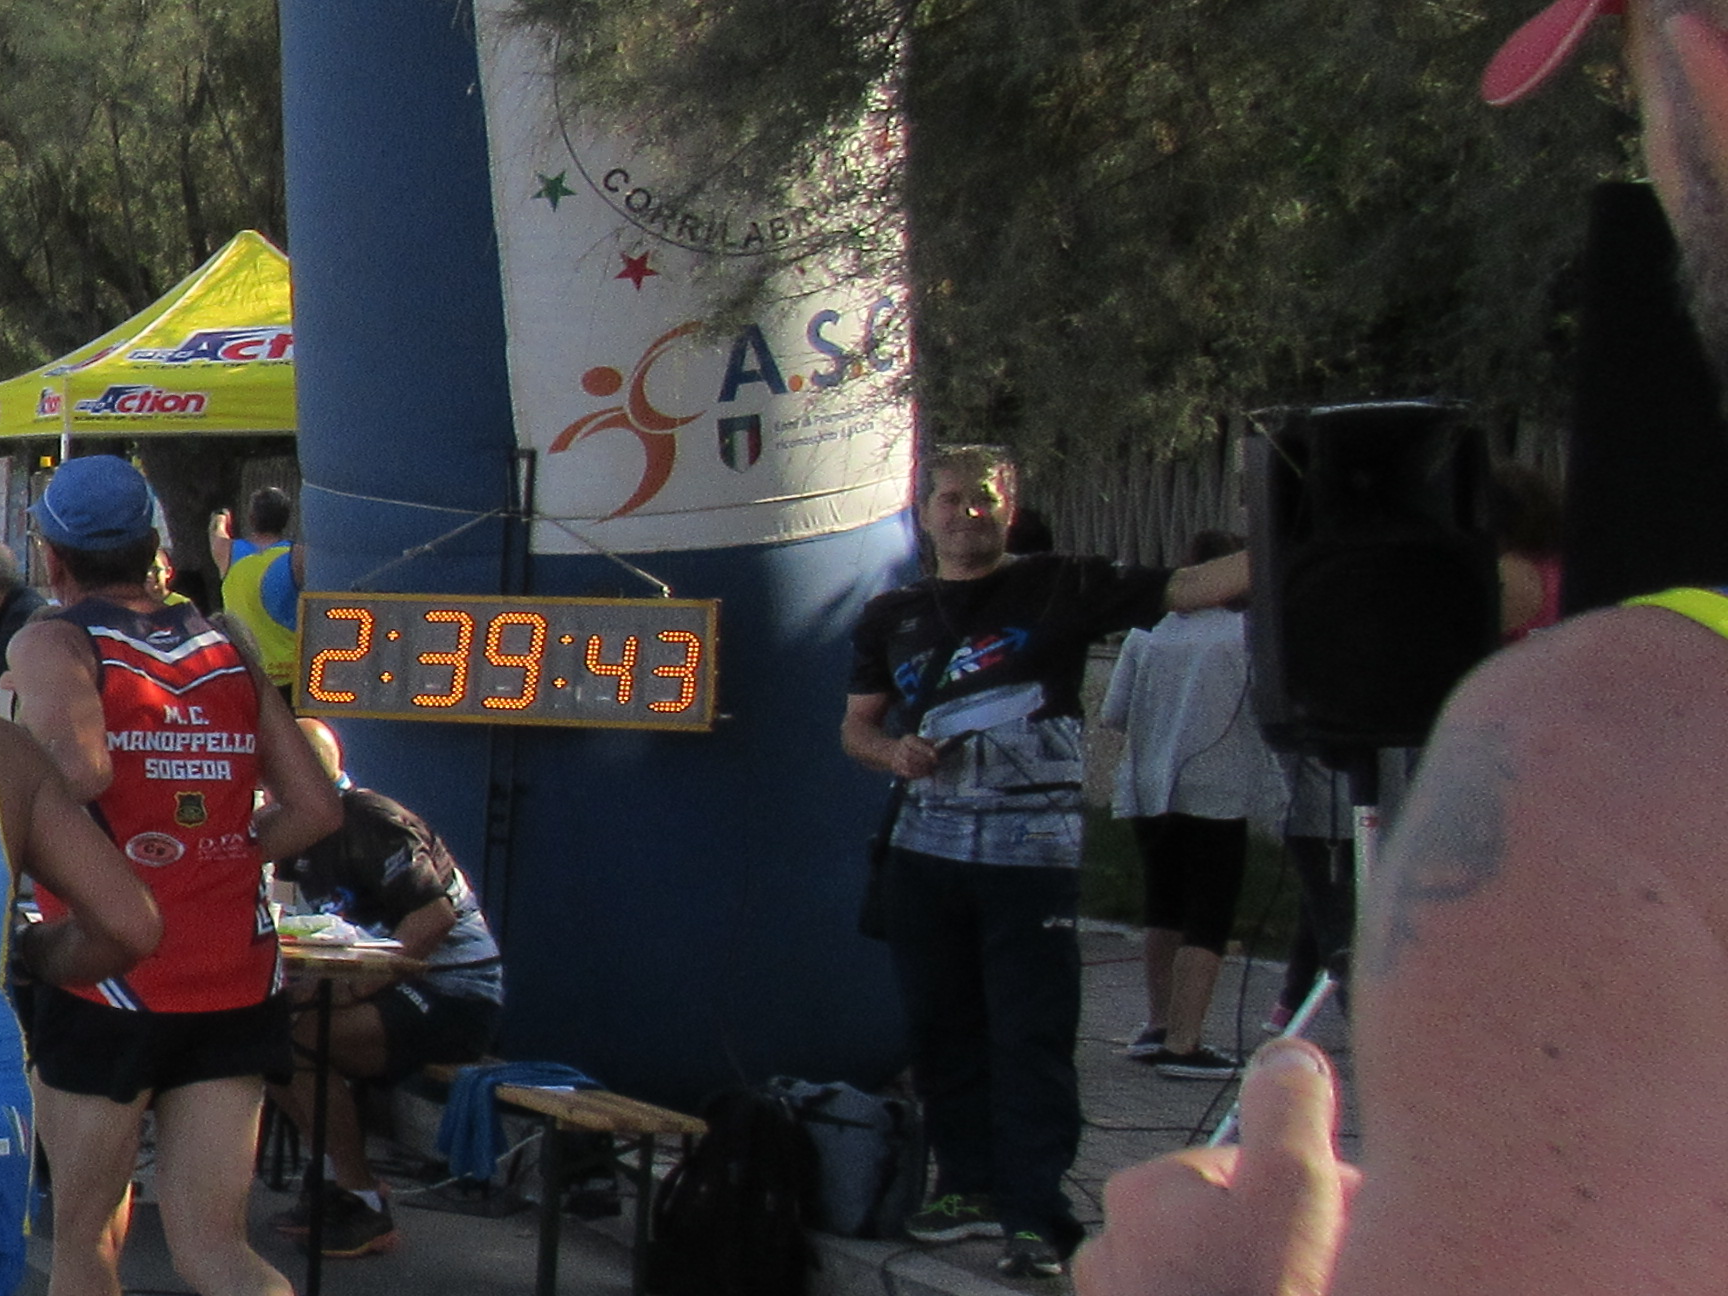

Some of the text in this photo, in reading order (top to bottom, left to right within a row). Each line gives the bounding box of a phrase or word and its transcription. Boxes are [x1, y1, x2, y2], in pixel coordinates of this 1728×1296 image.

[92, 386, 208, 414] Action
[308, 608, 701, 713] 2:39:43
[106, 731, 256, 754] MANOPPELLO
[145, 758, 233, 780] SOGEDA
